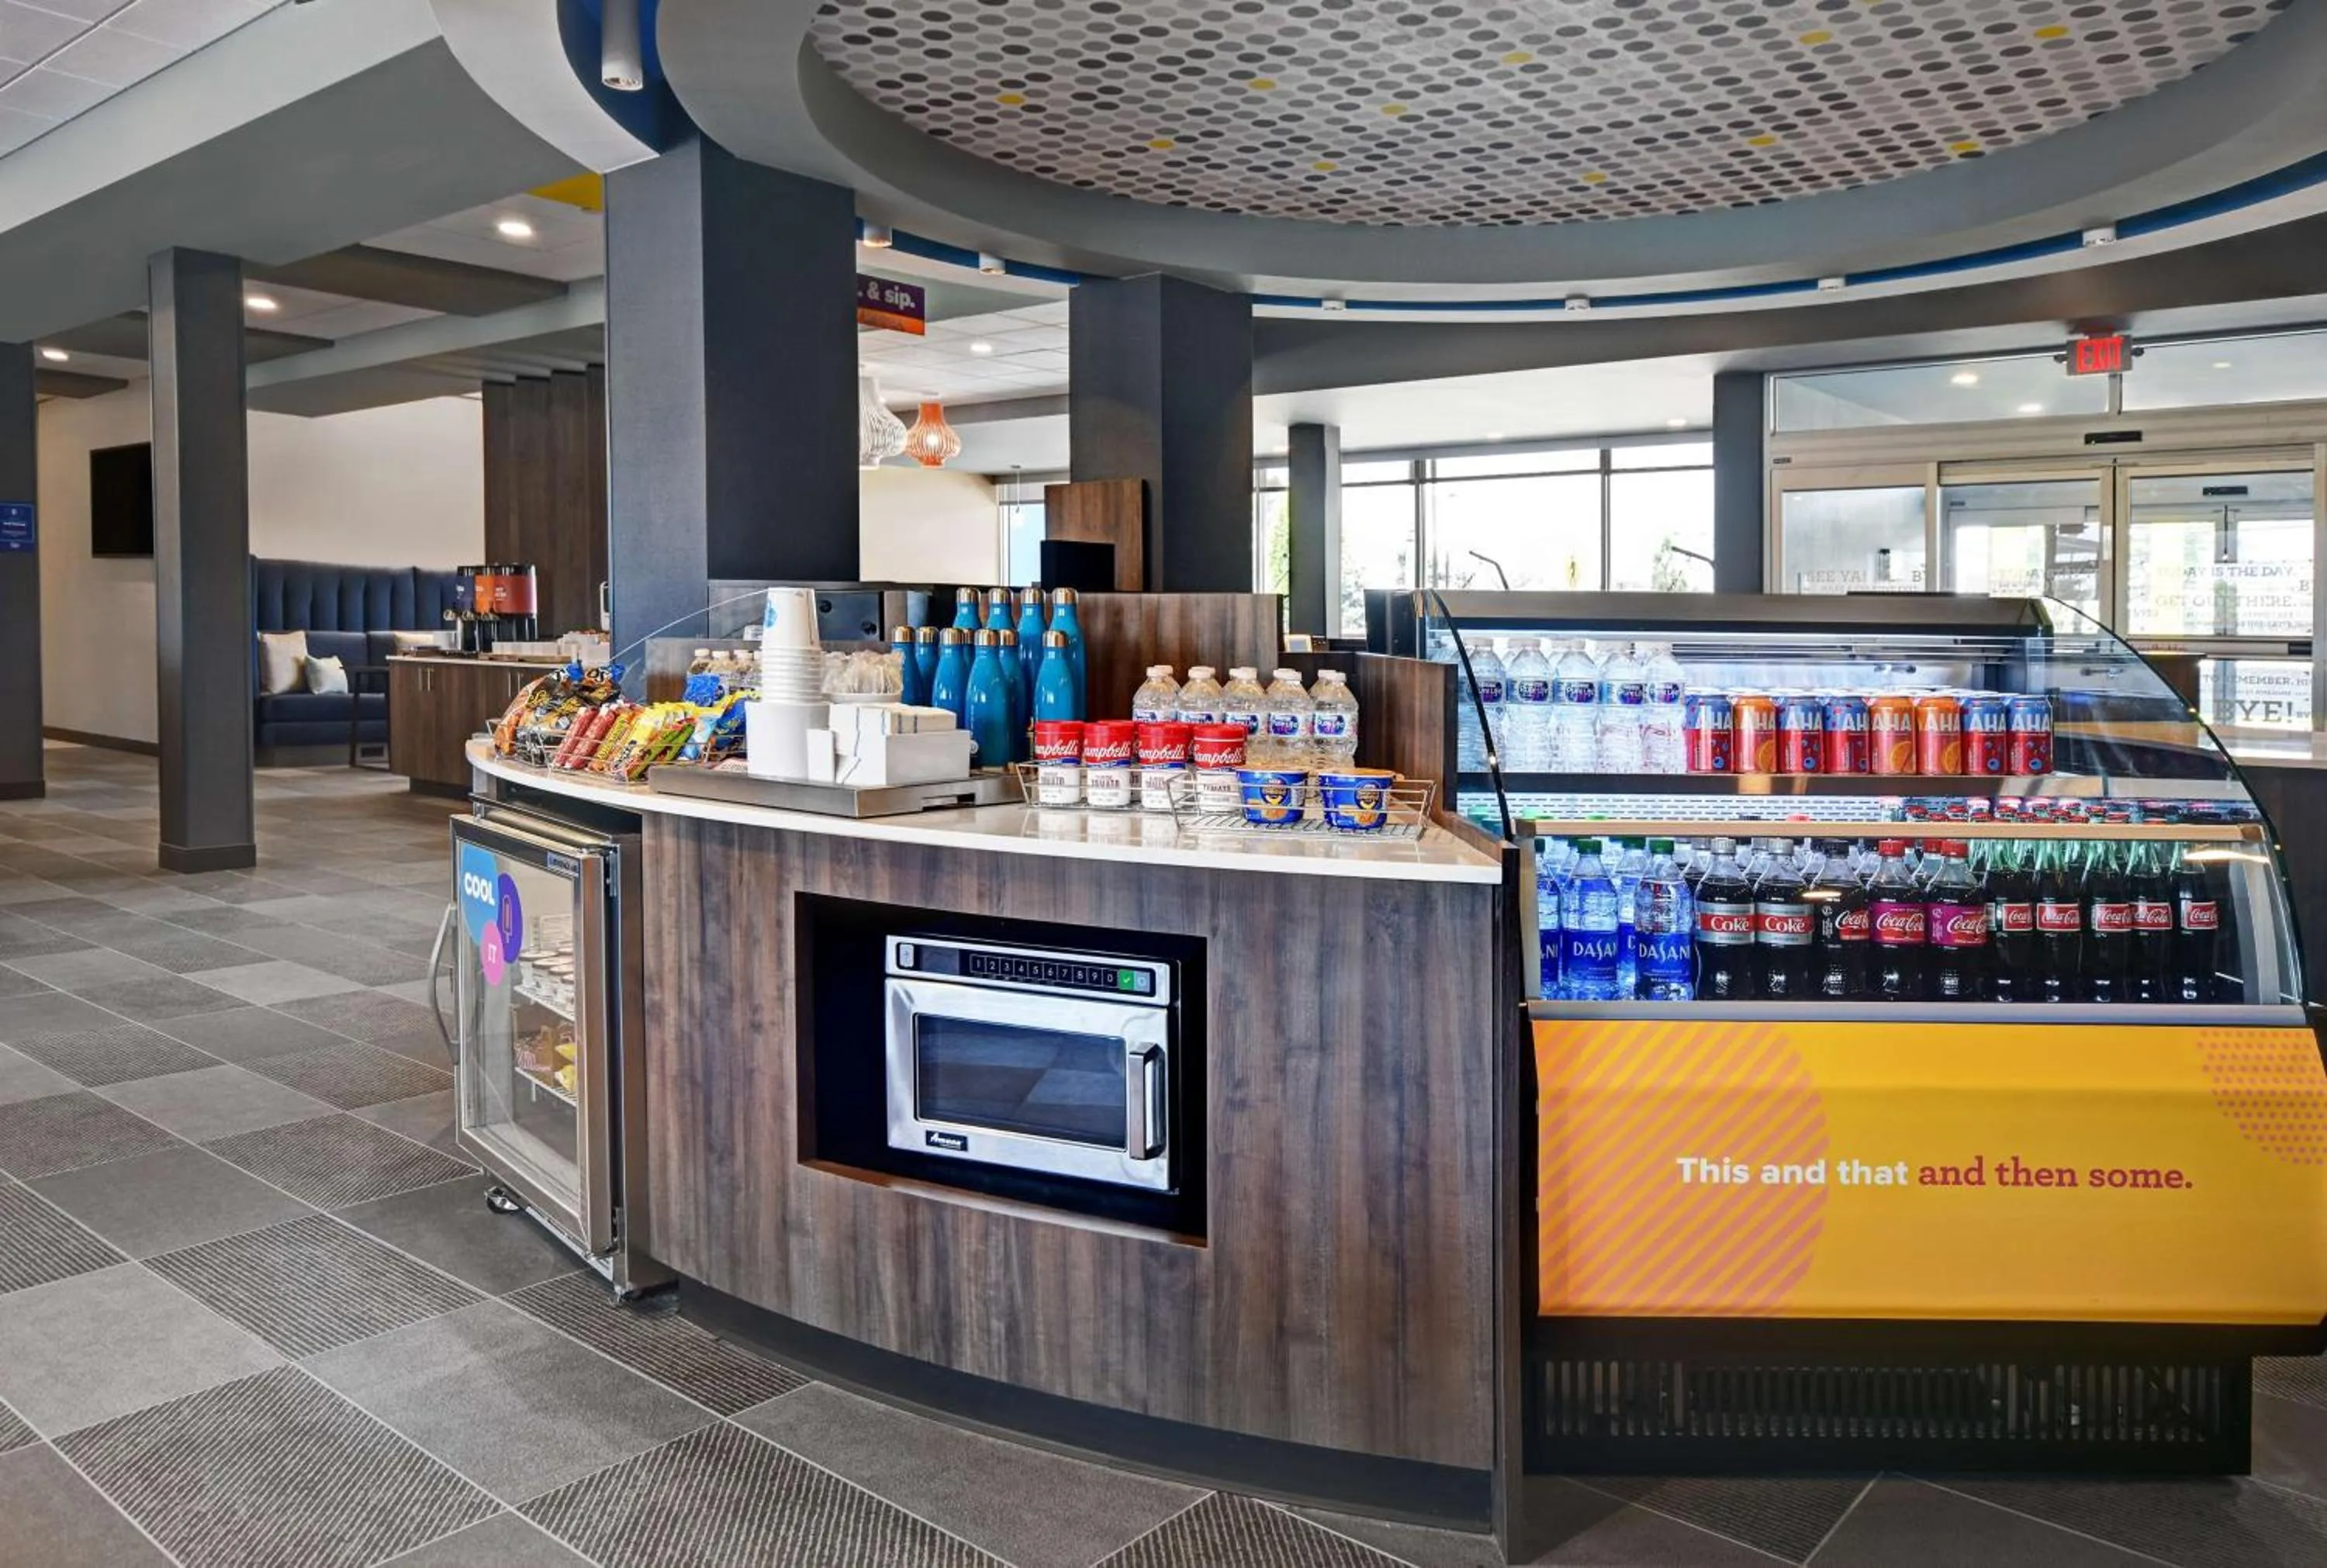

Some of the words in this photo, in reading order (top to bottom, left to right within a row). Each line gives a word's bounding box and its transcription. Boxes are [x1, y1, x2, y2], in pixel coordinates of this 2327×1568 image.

[884, 285, 915, 311] sip.
[2076, 337, 2122, 372] EXIT
[2211, 567, 2224, 577] IS
[2227, 567, 2257, 577] THE
[1696, 706, 1733, 730] AHA
[1740, 707, 1776, 730] AHA
[1786, 706, 1823, 730] AHA
[2213, 699, 2294, 723] BYE!
[1872, 713, 1912, 731] AHA
[1925, 713, 1961, 731] AHA
[1969, 713, 2007, 732] AHA
[2011, 713, 2051, 732] AHA
[464, 872, 496, 907] COOL
[1710, 916, 1749, 932] Coke
[1765, 916, 1805, 933] Coke
[487, 943, 498, 963] IT
[1675, 1156, 1751, 1183] This
[1760, 1159, 1826, 1184] and
[1837, 1159, 1909, 1185] that
[1918, 1155, 1986, 1186] and
[1995, 1155, 2079, 1187] then
[2088, 1168, 2194, 1189] some.
